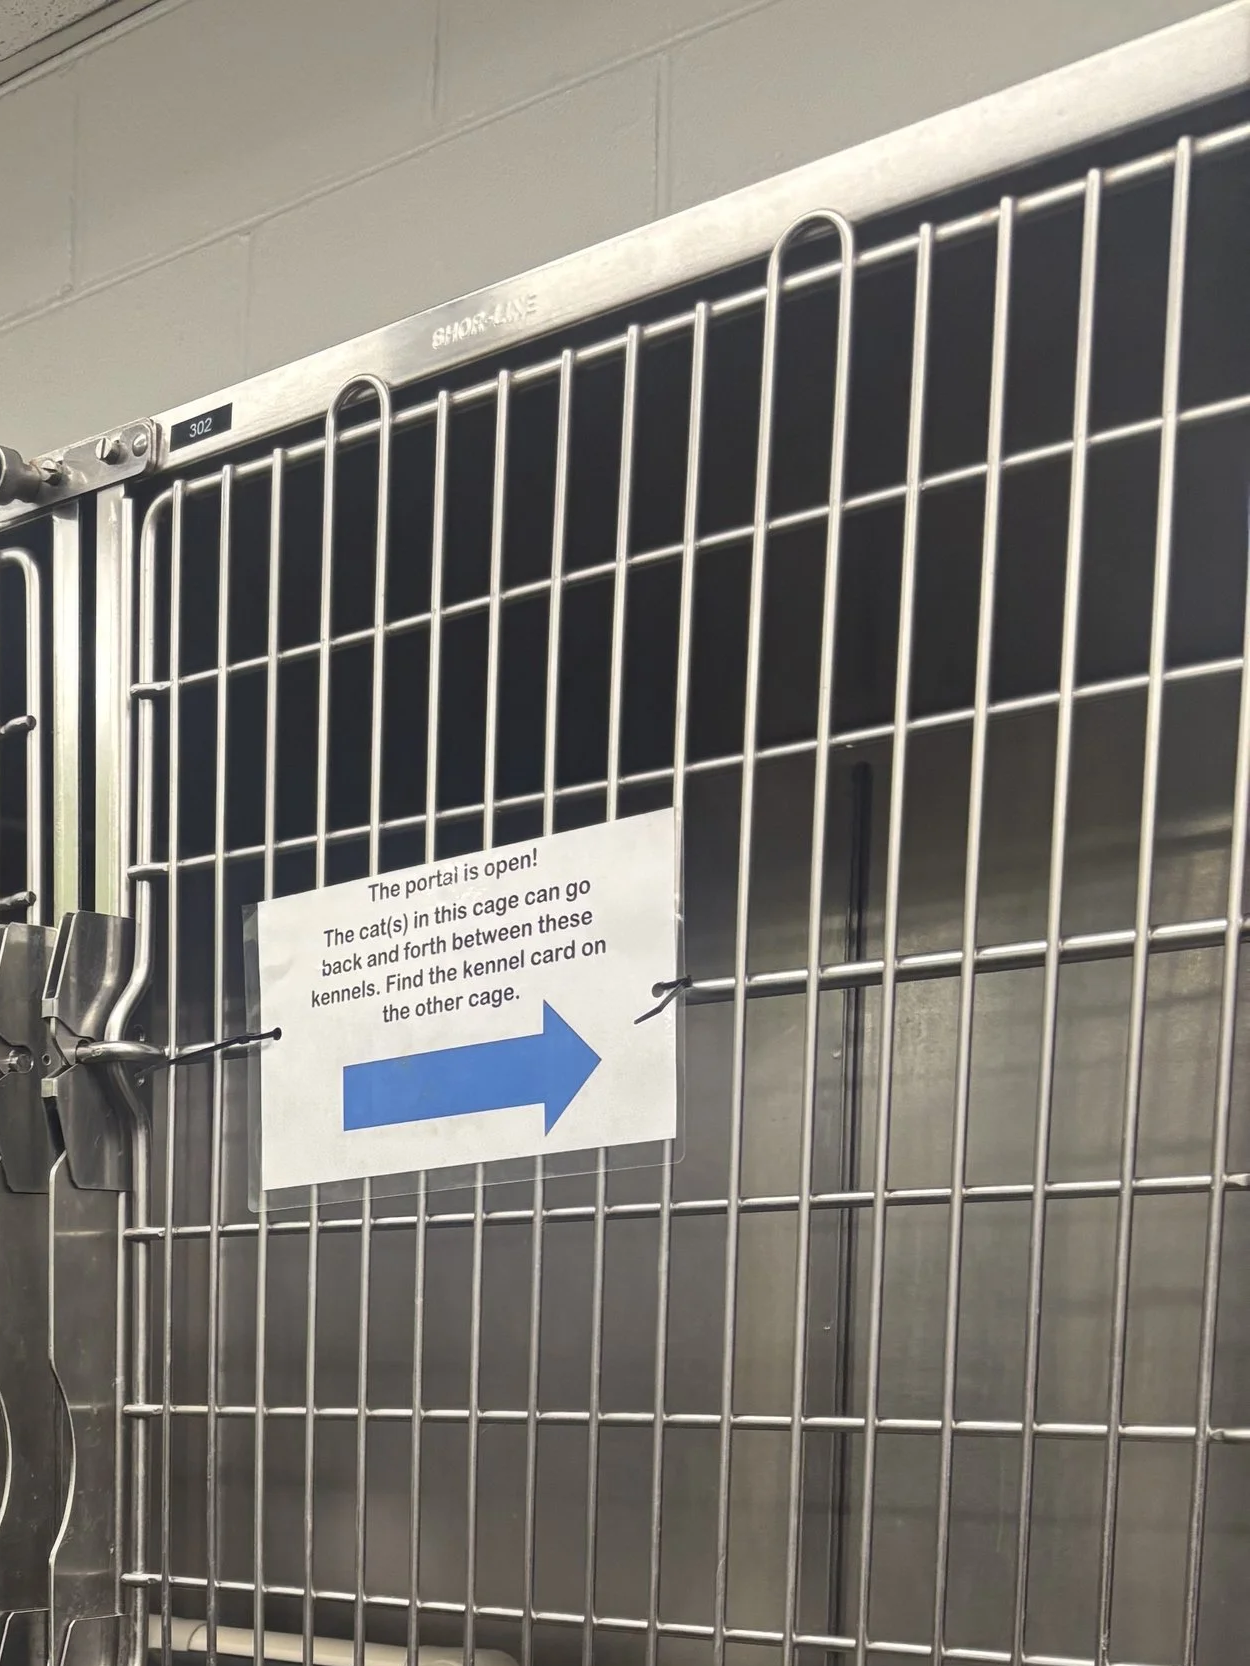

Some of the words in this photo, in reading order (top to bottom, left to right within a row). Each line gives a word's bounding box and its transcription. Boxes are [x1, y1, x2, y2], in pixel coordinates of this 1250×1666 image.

[189, 417, 213, 438] 302
[368, 882, 400, 902] The
[405, 866, 458, 899] portal
[464, 863, 479, 882] is
[484, 847, 538, 880] open!
[322, 953, 363, 976] back
[367, 944, 399, 968] and
[404, 936, 447, 960] forth
[452, 922, 532, 951] between
[538, 910, 593, 934] these
[323, 928, 354, 947] The
[359, 913, 408, 939] cat(s)
[414, 911, 429, 929] in
[434, 903, 467, 924] this
[472, 894, 519, 916] cage
[524, 885, 560, 905] can
[566, 879, 591, 902] go
[311, 980, 381, 1008] kennels.
[386, 969, 423, 993] Find
[428, 965, 457, 985] the
[463, 949, 524, 979] kennel
[531, 939, 576, 966] card
[581, 939, 606, 956] on
[382, 1004, 410, 1023] the
[415, 995, 464, 1016] other
[468, 986, 520, 1008] cage.
